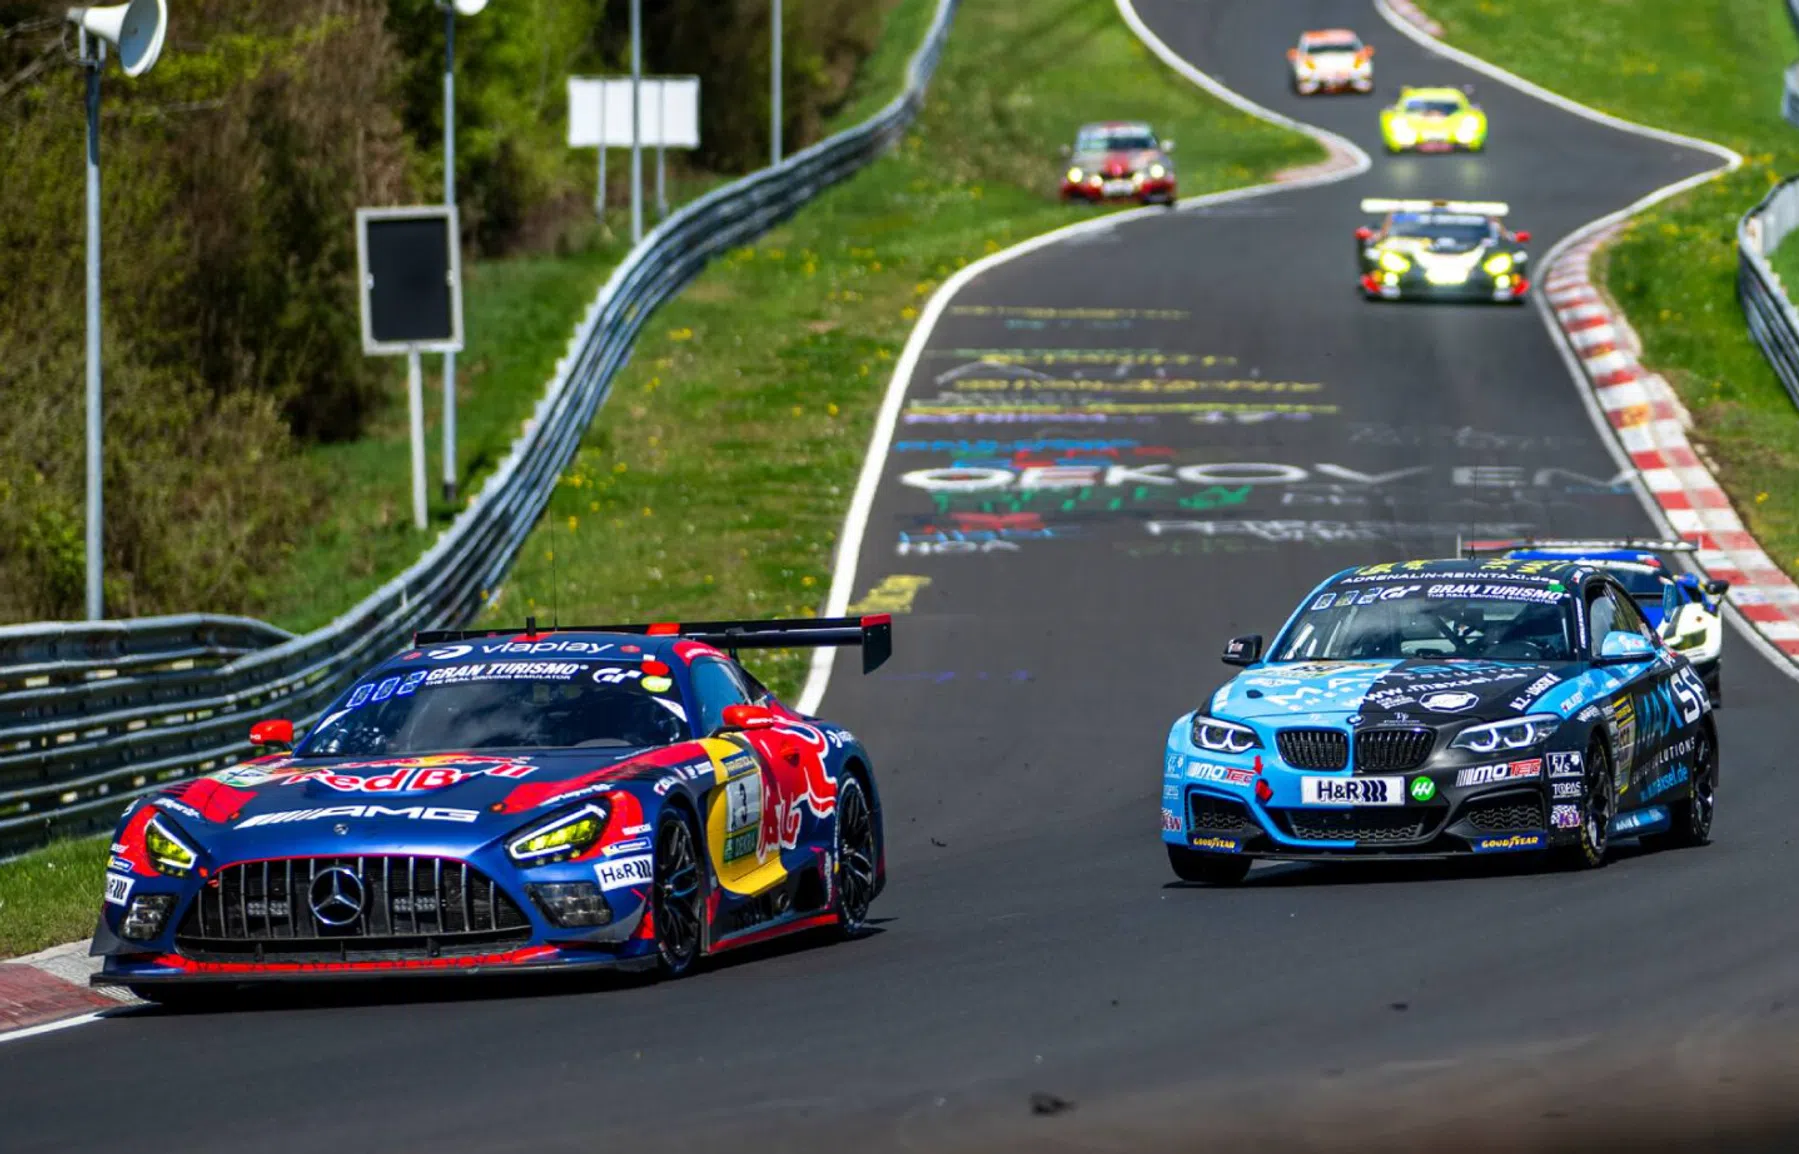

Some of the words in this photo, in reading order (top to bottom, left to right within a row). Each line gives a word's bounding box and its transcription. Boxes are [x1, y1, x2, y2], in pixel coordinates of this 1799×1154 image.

[1428, 584, 1477, 595] GRAN
[1481, 585, 1563, 600] TURISMO
[481, 640, 616, 654] viaplay
[428, 665, 488, 680] GRAN
[488, 663, 580, 676] TURISMO
[1193, 837, 1236, 849] GOODYEAR
[1481, 835, 1539, 849] GOODYEAR
